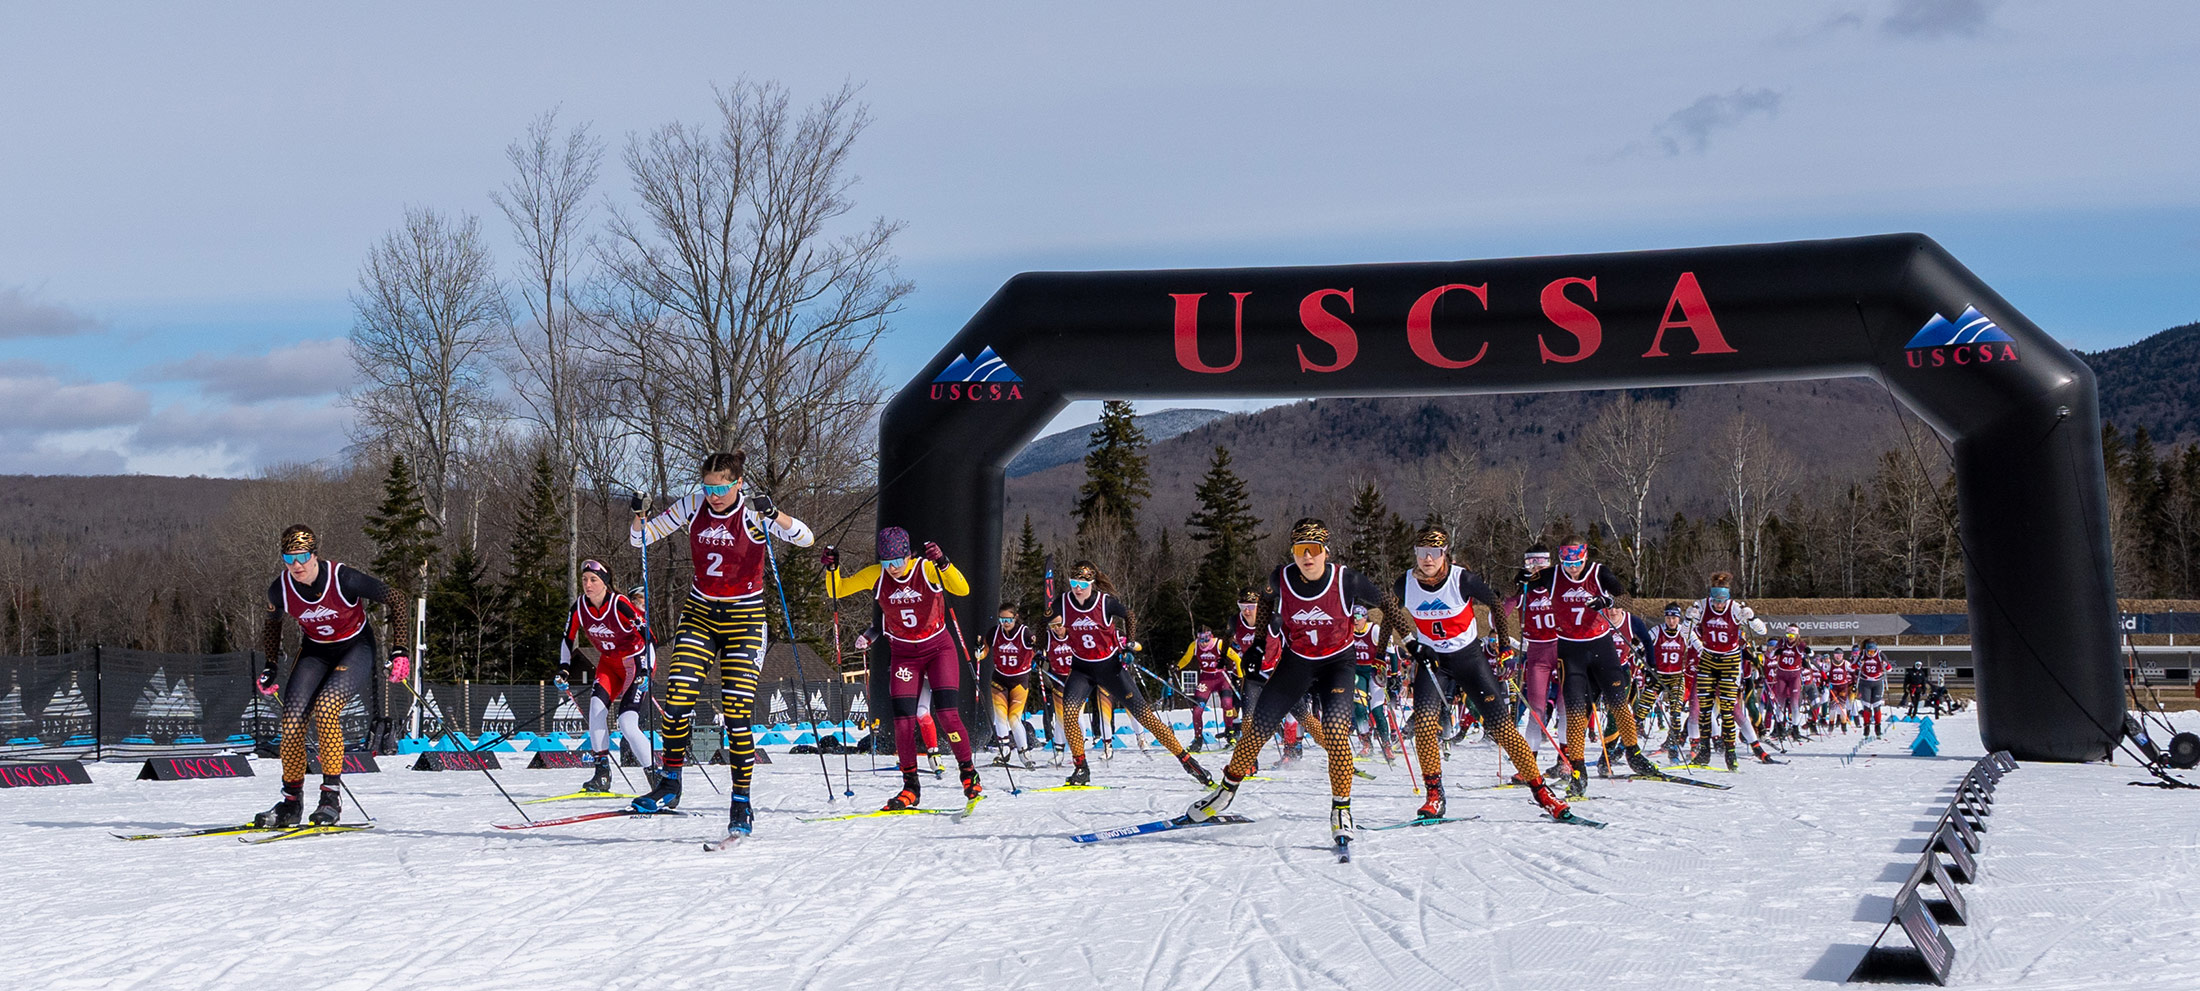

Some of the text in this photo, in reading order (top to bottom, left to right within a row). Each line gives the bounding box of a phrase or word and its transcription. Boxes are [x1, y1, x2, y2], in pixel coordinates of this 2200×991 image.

[1168, 271, 1738, 374] USCSA
[1905, 343, 2019, 369] USCSA
[930, 382, 1023, 401] USCSA
[698, 536, 735, 546] USCSA
[706, 552, 724, 577] 2
[747, 581, 753, 590] 2
[890, 596, 922, 604] USCSA
[301, 613, 339, 623] USCSA
[900, 609, 918, 628] 5
[1532, 613, 1556, 629] 10
[1571, 607, 1586, 626] 7
[2118, 616, 2136, 629] id
[316, 625, 335, 636] 3
[1432, 621, 1446, 638] 4
[1770, 621, 1790, 630] VAN
[1081, 634, 1096, 649] 8
[1305, 629, 1318, 646] 1
[1709, 630, 1729, 643] 16
[1000, 655, 1018, 667] 15
[1056, 655, 1073, 666] 18
[1661, 652, 1680, 664] 19
[1782, 656, 1795, 666] 40
[402, 719, 442, 732] UCSA
[481, 720, 515, 734] USCSA
[552, 721, 583, 733] USCSA
[169, 758, 238, 778] USCSA
[0, 764, 72, 787] USCSA
